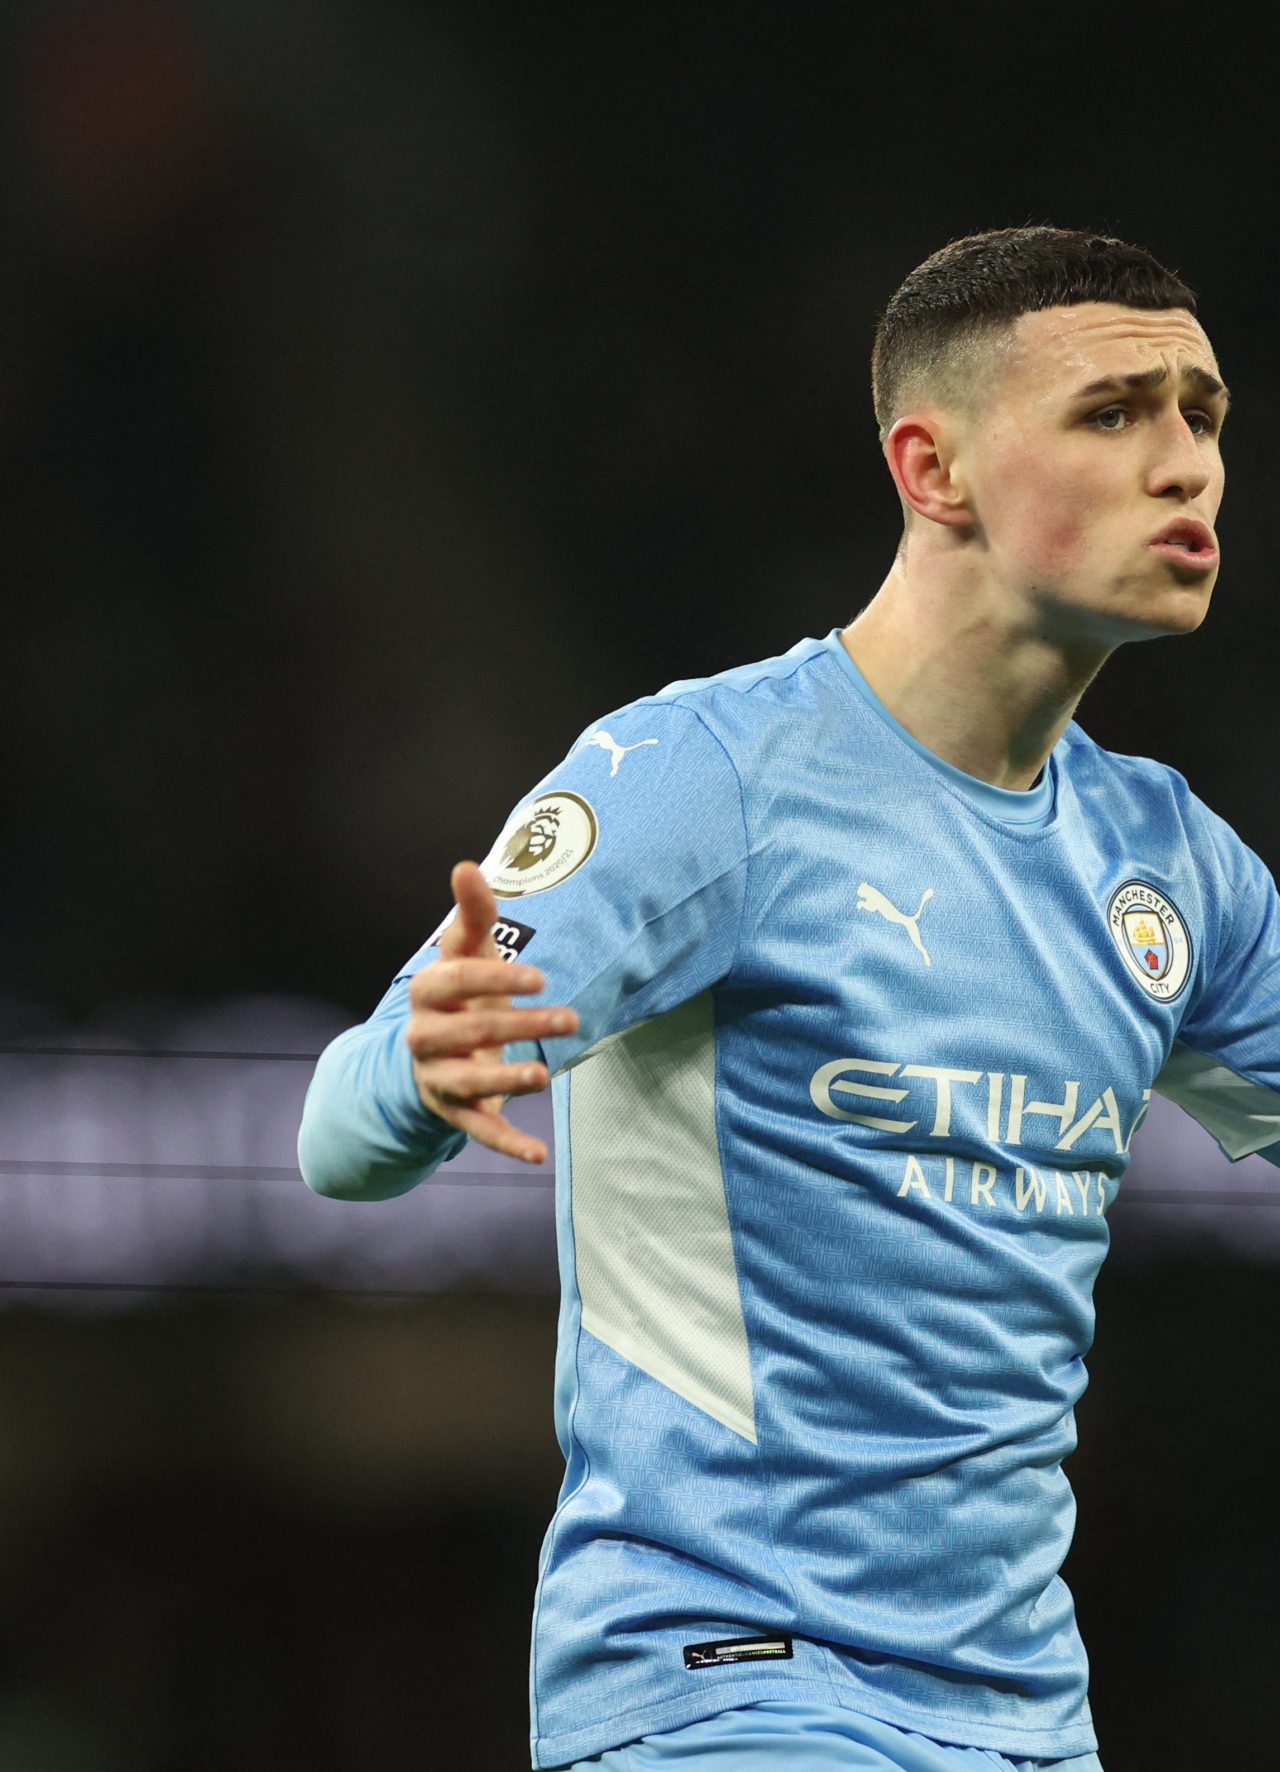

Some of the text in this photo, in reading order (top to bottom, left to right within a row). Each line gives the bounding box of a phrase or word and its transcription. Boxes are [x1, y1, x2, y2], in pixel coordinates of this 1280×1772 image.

[544, 848, 575, 875] 2020/21
[1112, 889, 1175, 928] MANCHESTER
[1149, 983, 1170, 994] CITY
[896, 1154, 1109, 1217] AIRWAYS
